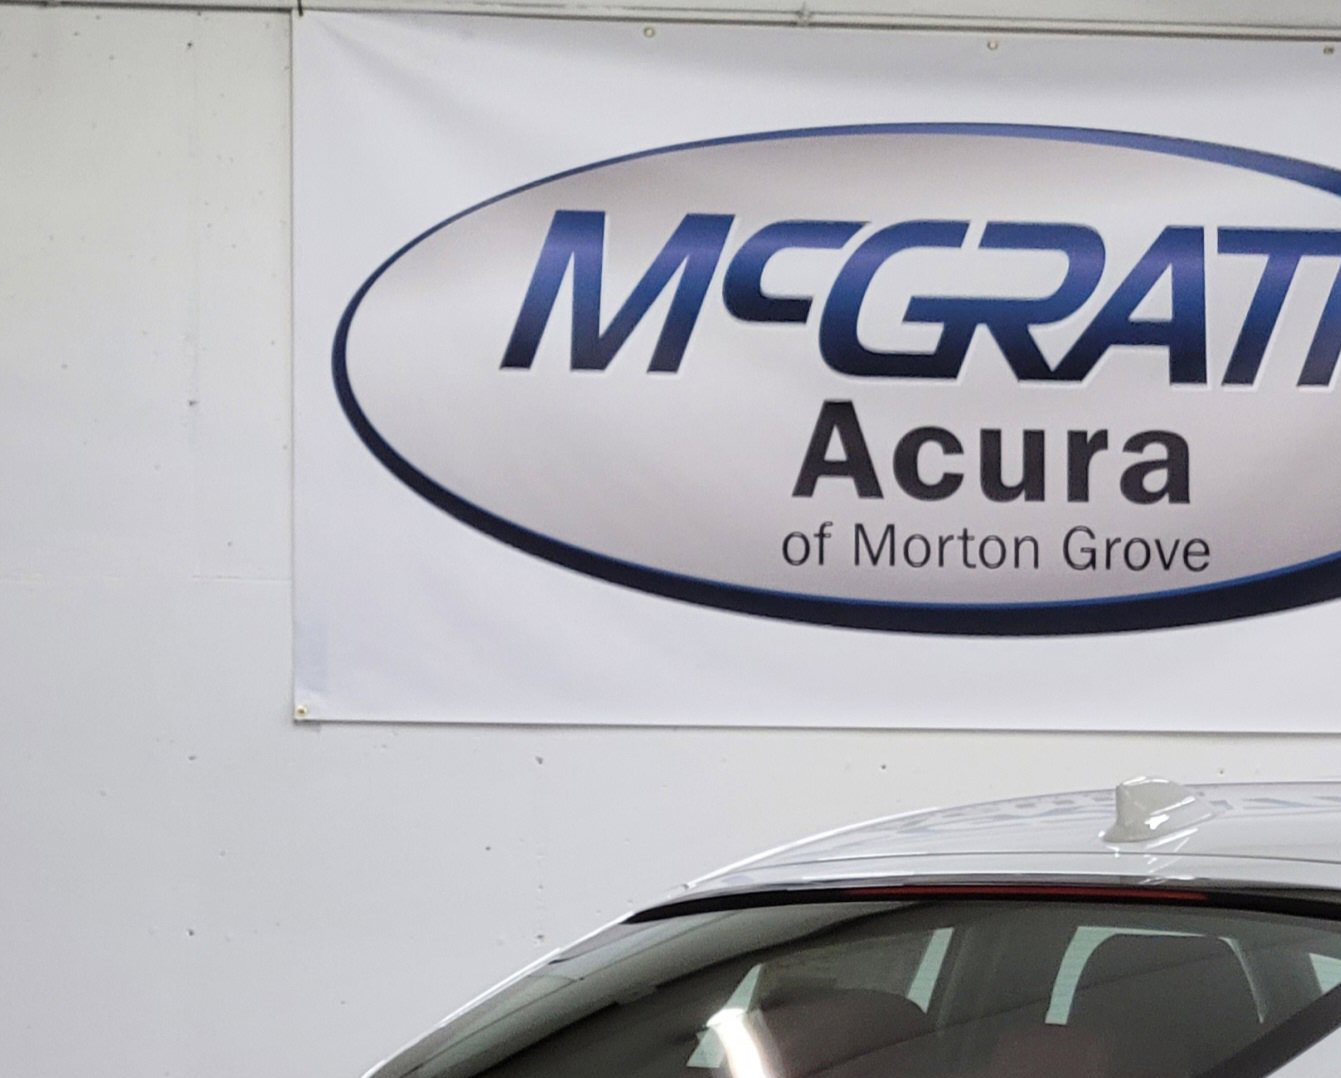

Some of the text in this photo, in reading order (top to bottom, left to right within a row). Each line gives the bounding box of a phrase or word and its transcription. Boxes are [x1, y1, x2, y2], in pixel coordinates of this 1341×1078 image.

[792, 399, 1191, 505] Acura
[782, 521, 1211, 573] of Morton Grove
